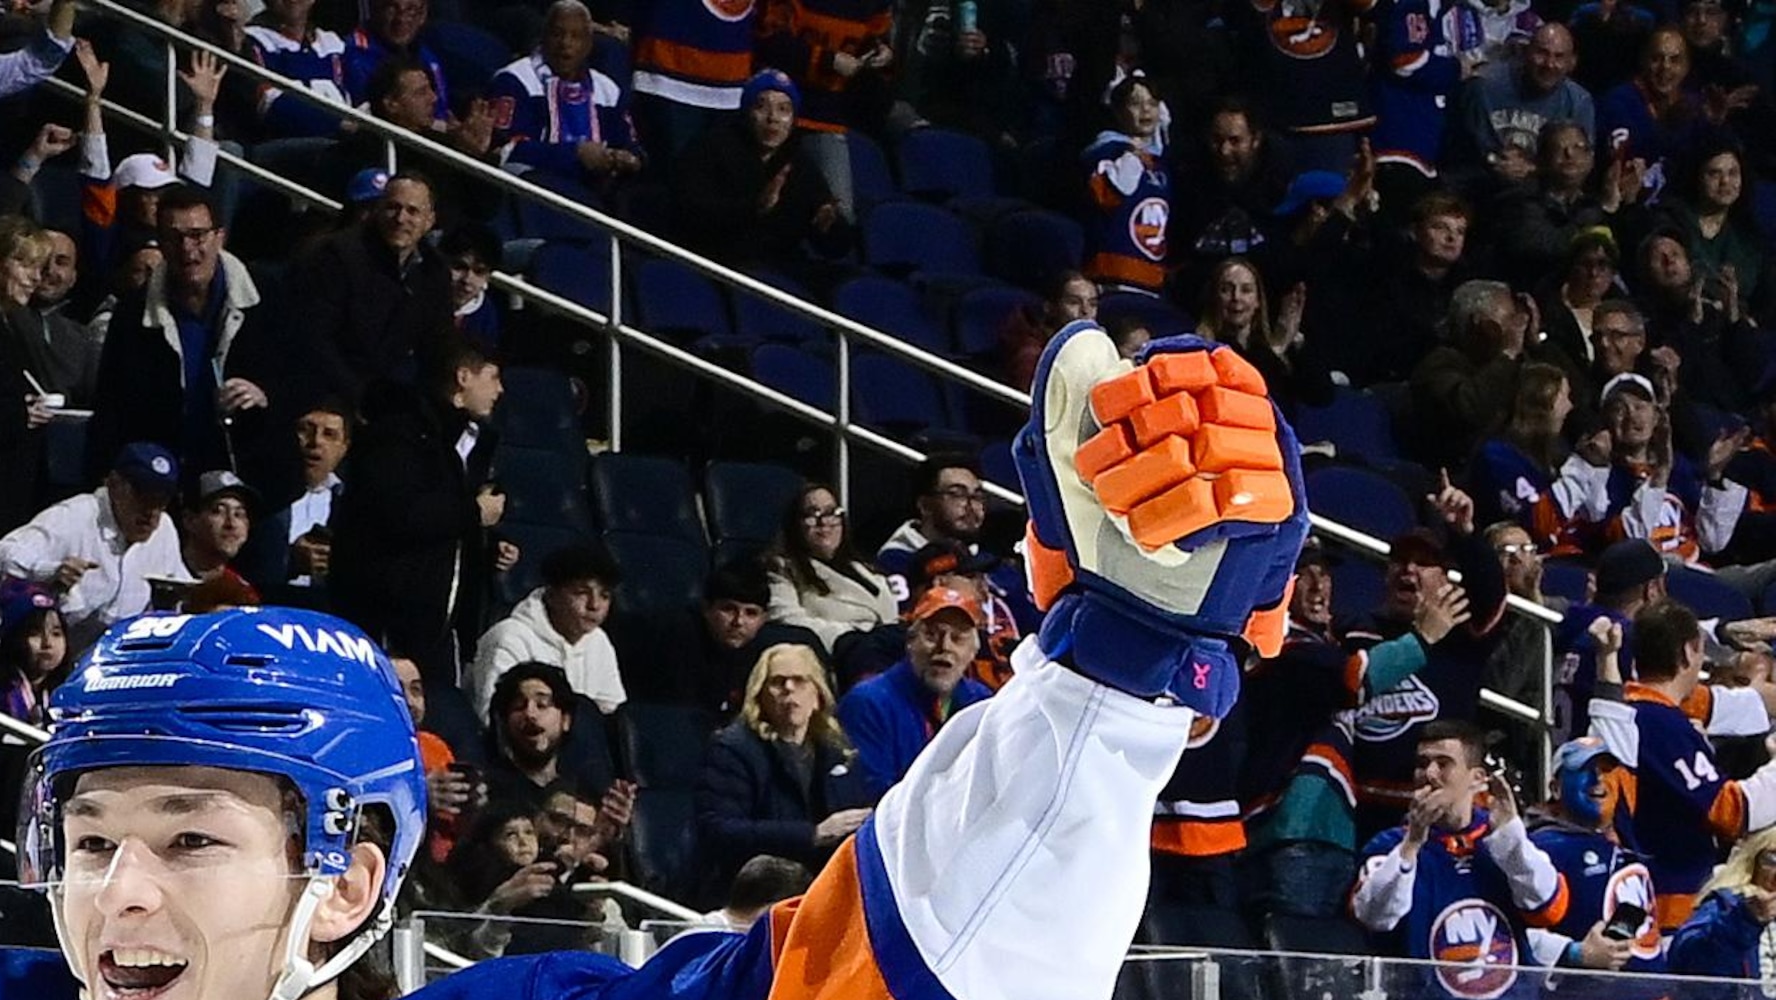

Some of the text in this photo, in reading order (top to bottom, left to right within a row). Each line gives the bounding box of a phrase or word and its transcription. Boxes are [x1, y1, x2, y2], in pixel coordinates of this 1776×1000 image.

[257, 623, 378, 669] VIAM
[84, 673, 180, 693] WARRIOR
[1674, 751, 1719, 791] 14
